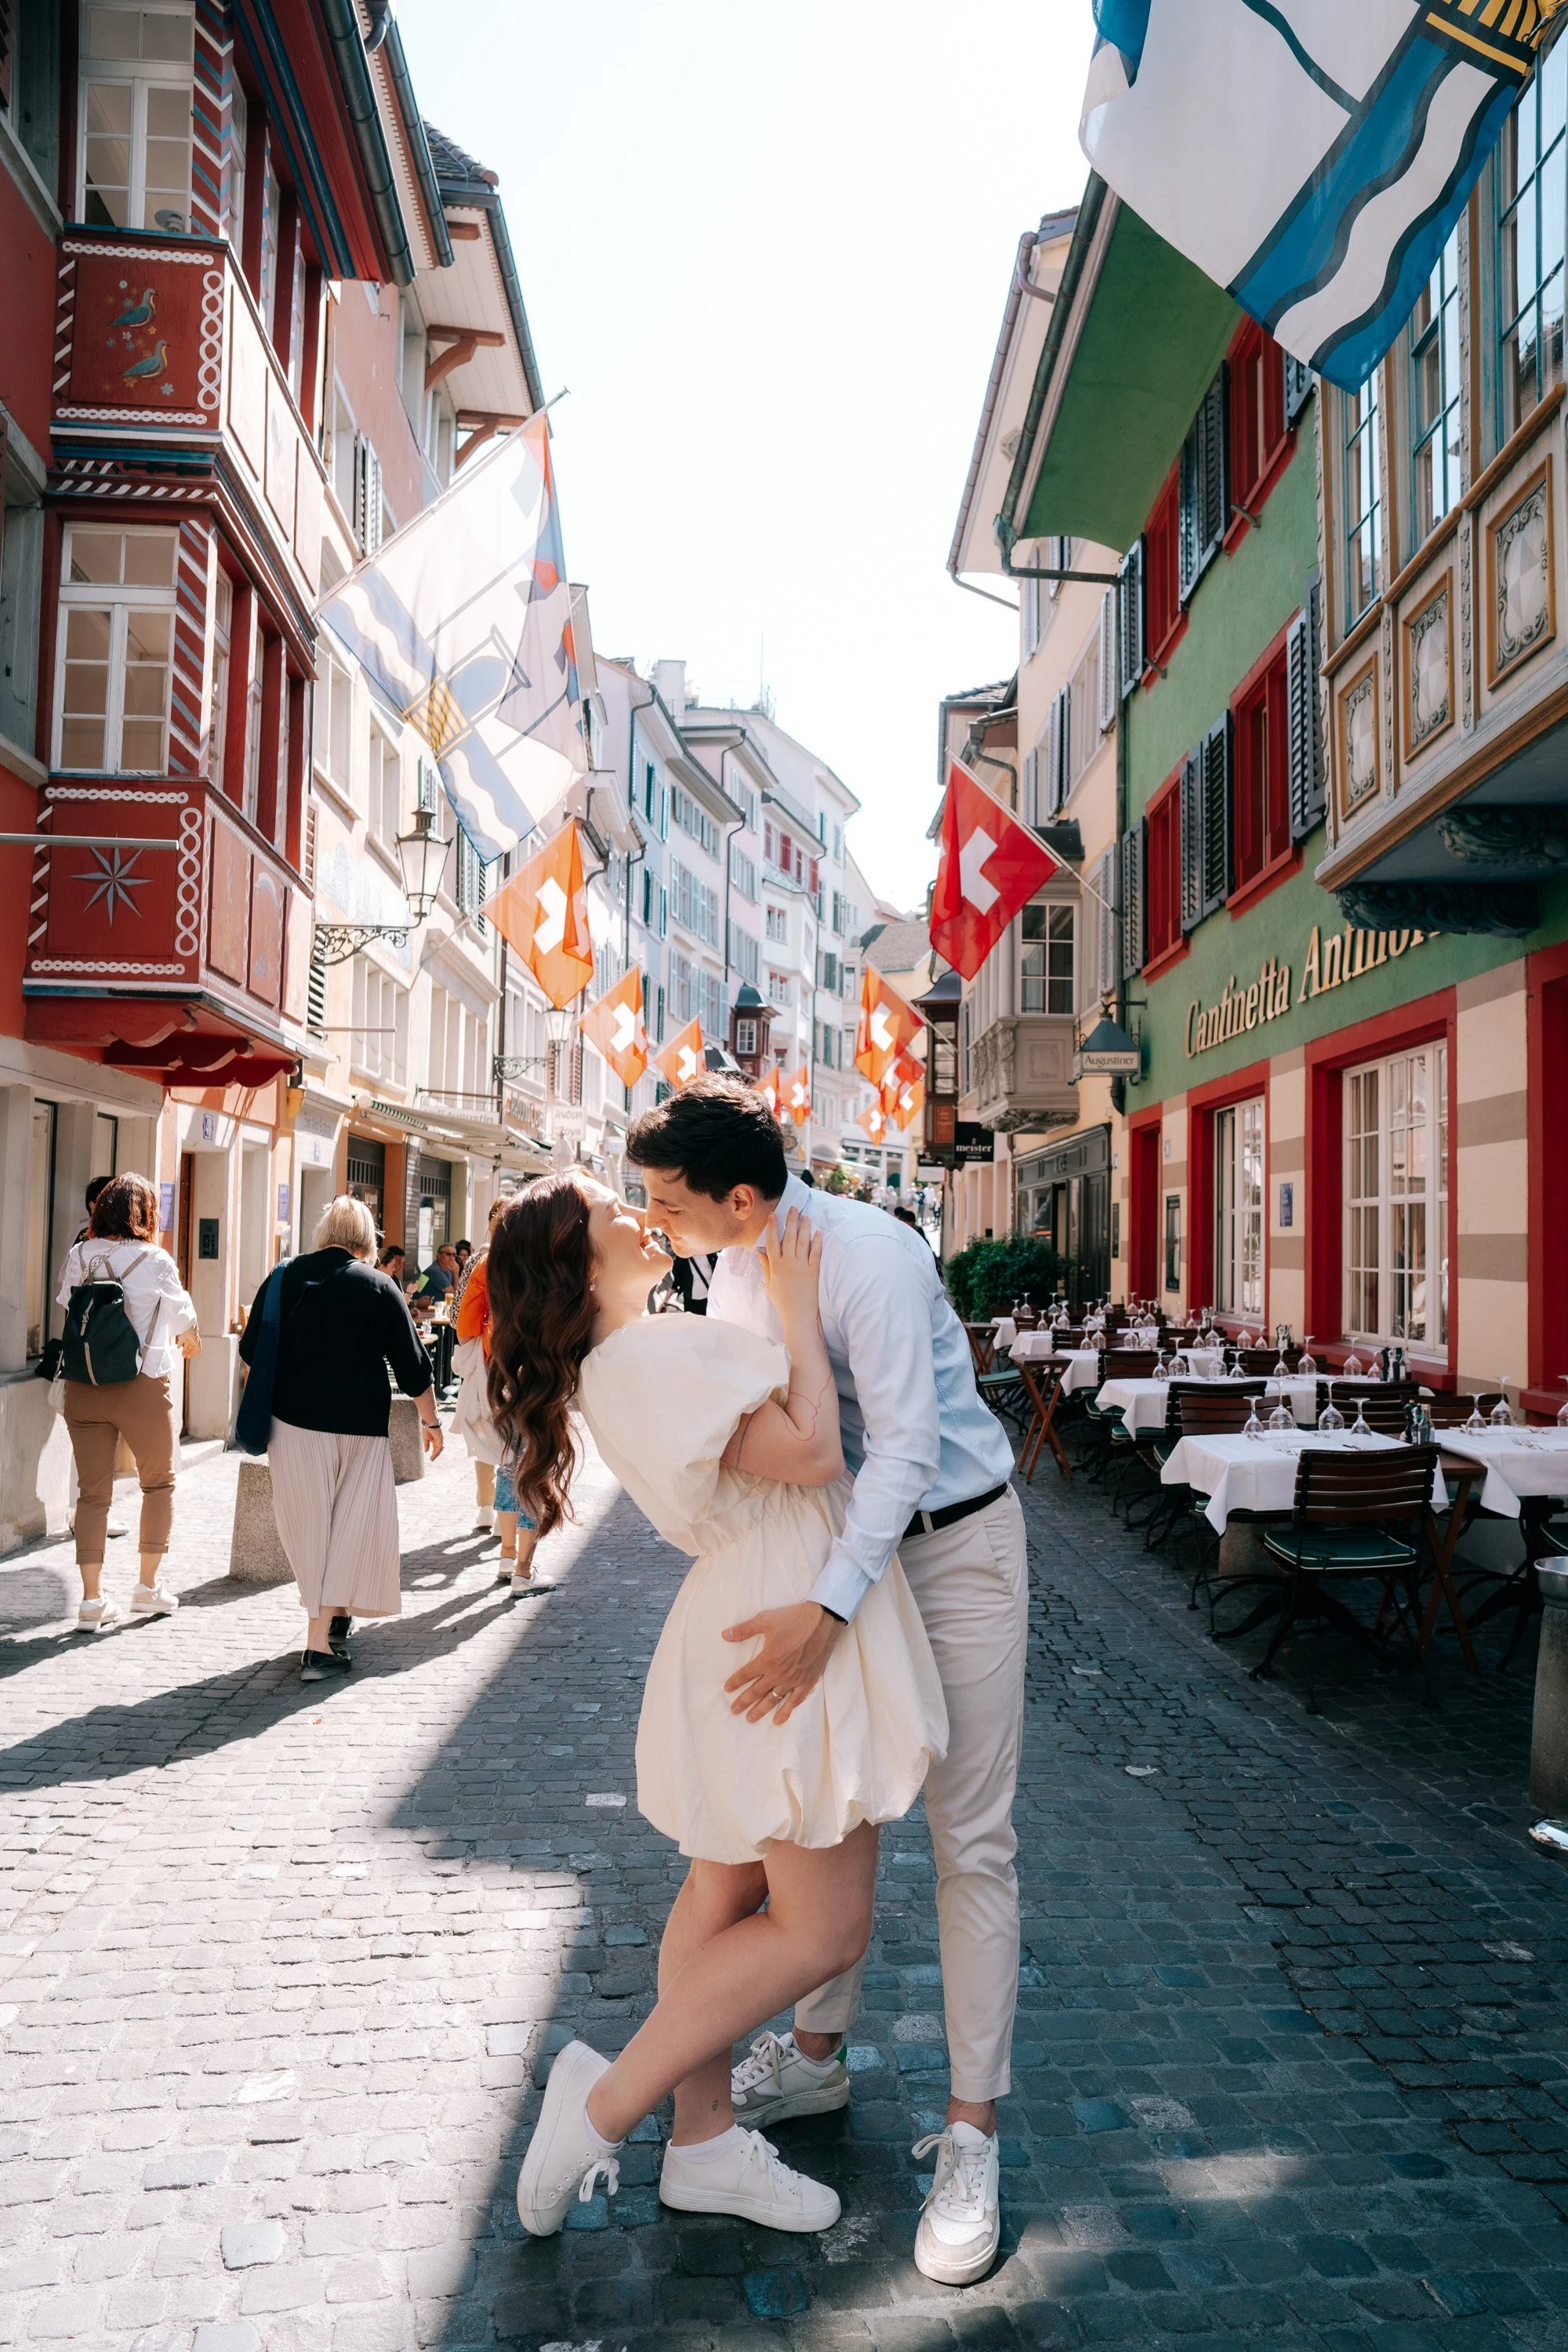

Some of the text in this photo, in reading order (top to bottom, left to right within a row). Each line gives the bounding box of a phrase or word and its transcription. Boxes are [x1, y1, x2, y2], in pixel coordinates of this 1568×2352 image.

[1184, 923, 1441, 1059] Cantinetta Antino
[1085, 1055, 1134, 1069] Augustiner
